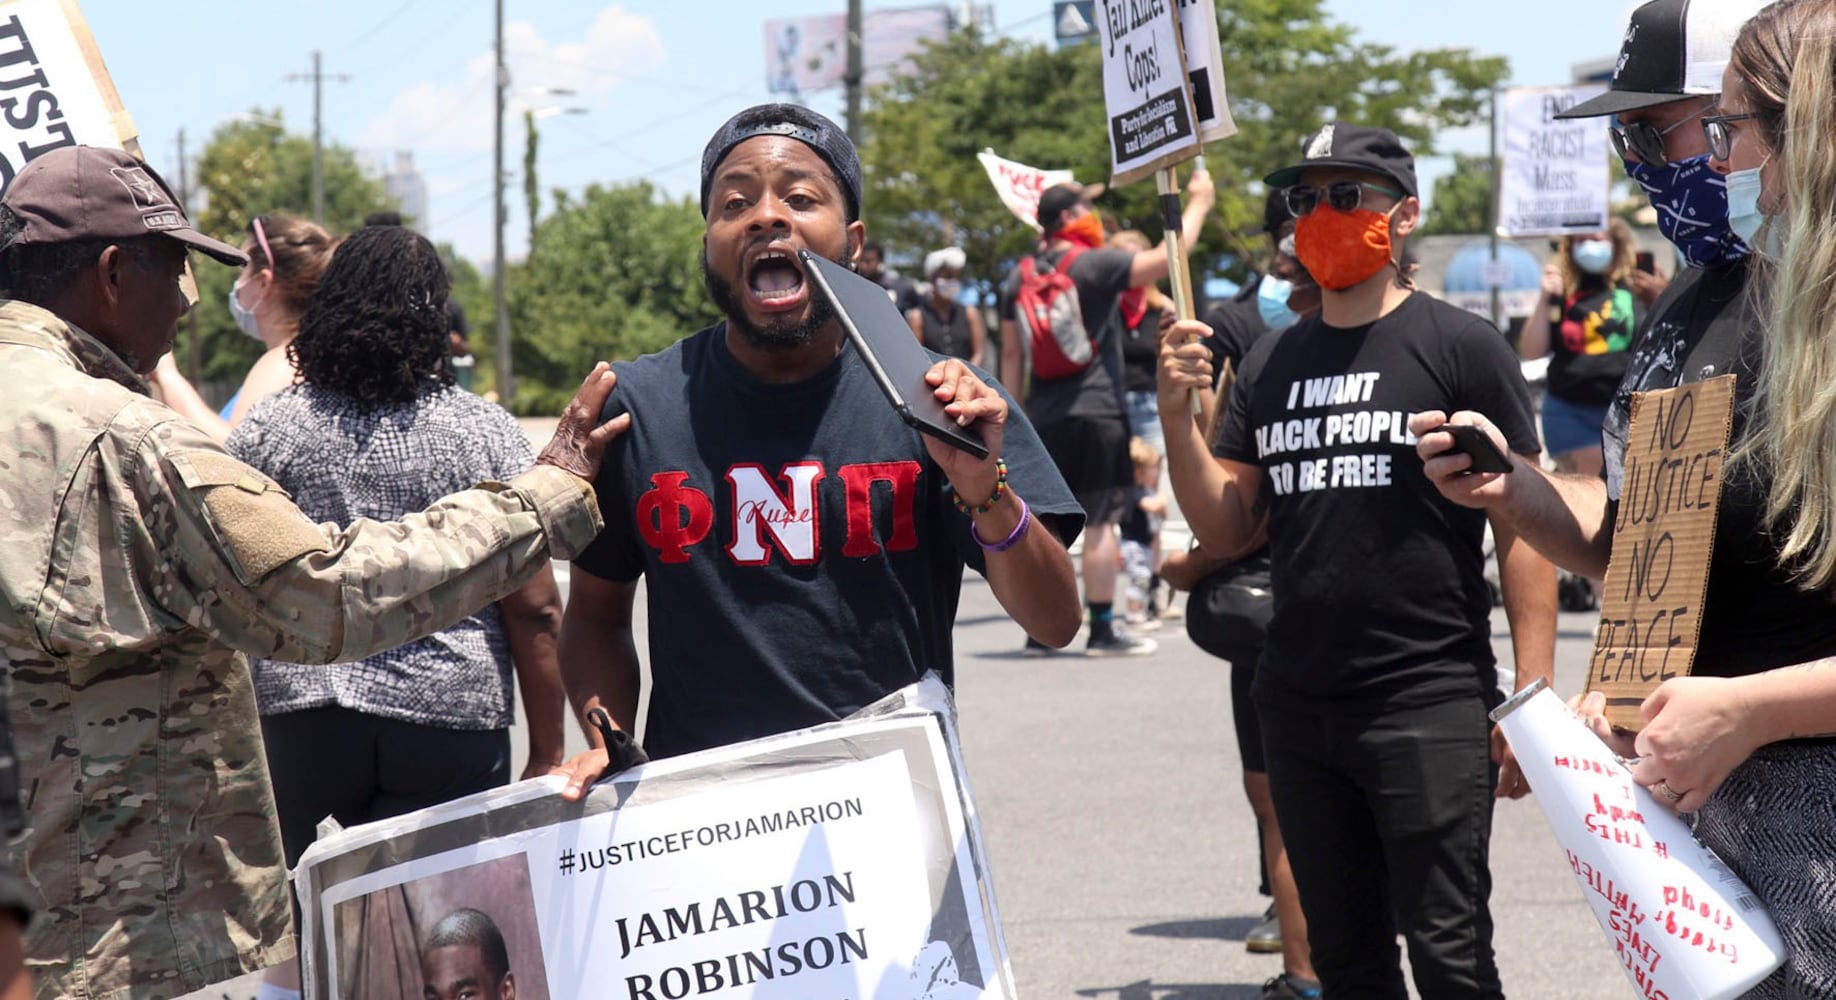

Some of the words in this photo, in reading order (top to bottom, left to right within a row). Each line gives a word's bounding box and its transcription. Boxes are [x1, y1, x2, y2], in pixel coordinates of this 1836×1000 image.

[1124, 28, 1161, 100] Cops!
[1529, 128, 1586, 161] RACIST
[1286, 381, 1300, 410] I
[1303, 372, 1380, 408] WANT
[1649, 390, 1694, 452] NO
[1269, 462, 1294, 496] TO
[1299, 458, 1328, 492] BE
[1331, 454, 1392, 488] FREE
[1616, 450, 1722, 533] JUSTICE
[1625, 532, 1674, 602] NO
[1586, 606, 1688, 692] PEACE
[559, 797, 863, 877] #JUSTICEFORJAMARION
[1584, 813, 1642, 849] THIS
[615, 872, 856, 959] JAMARION
[625, 928, 869, 1000] ROBINSON
